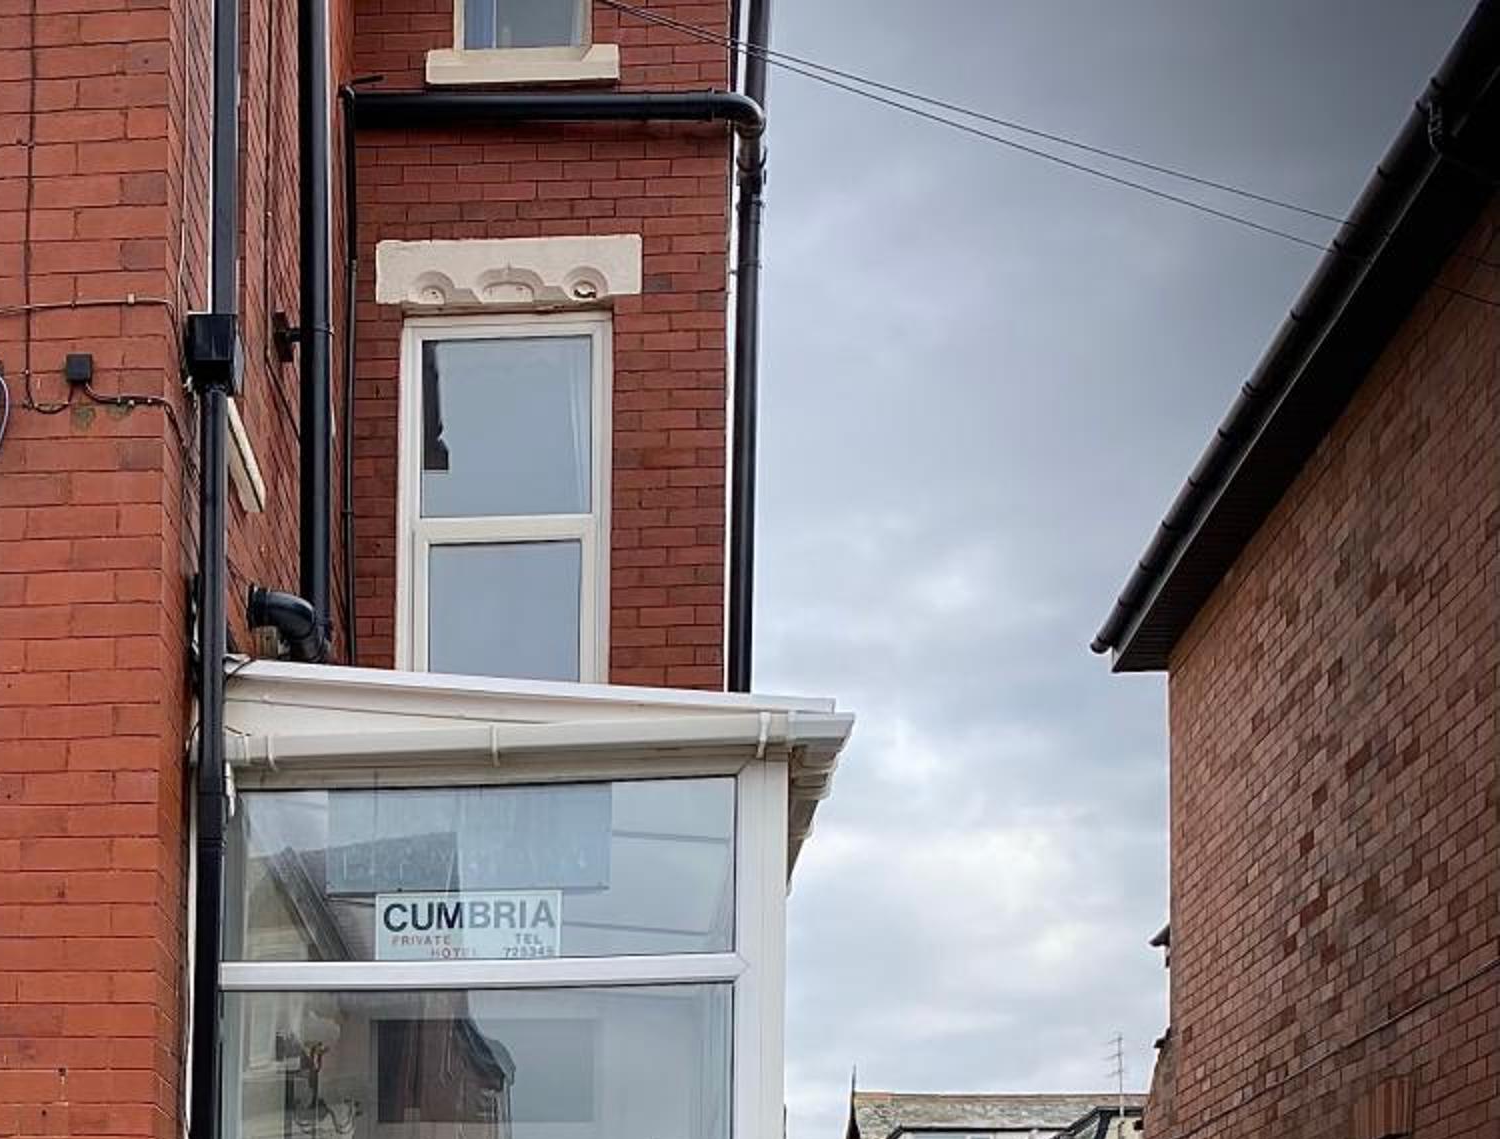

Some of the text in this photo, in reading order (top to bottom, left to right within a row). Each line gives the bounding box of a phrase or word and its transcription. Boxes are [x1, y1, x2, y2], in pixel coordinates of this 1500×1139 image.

[383, 901, 556, 932] CUMBRIA
[391, 935, 451, 945] PRIVATE
[515, 933, 543, 945] TEL
